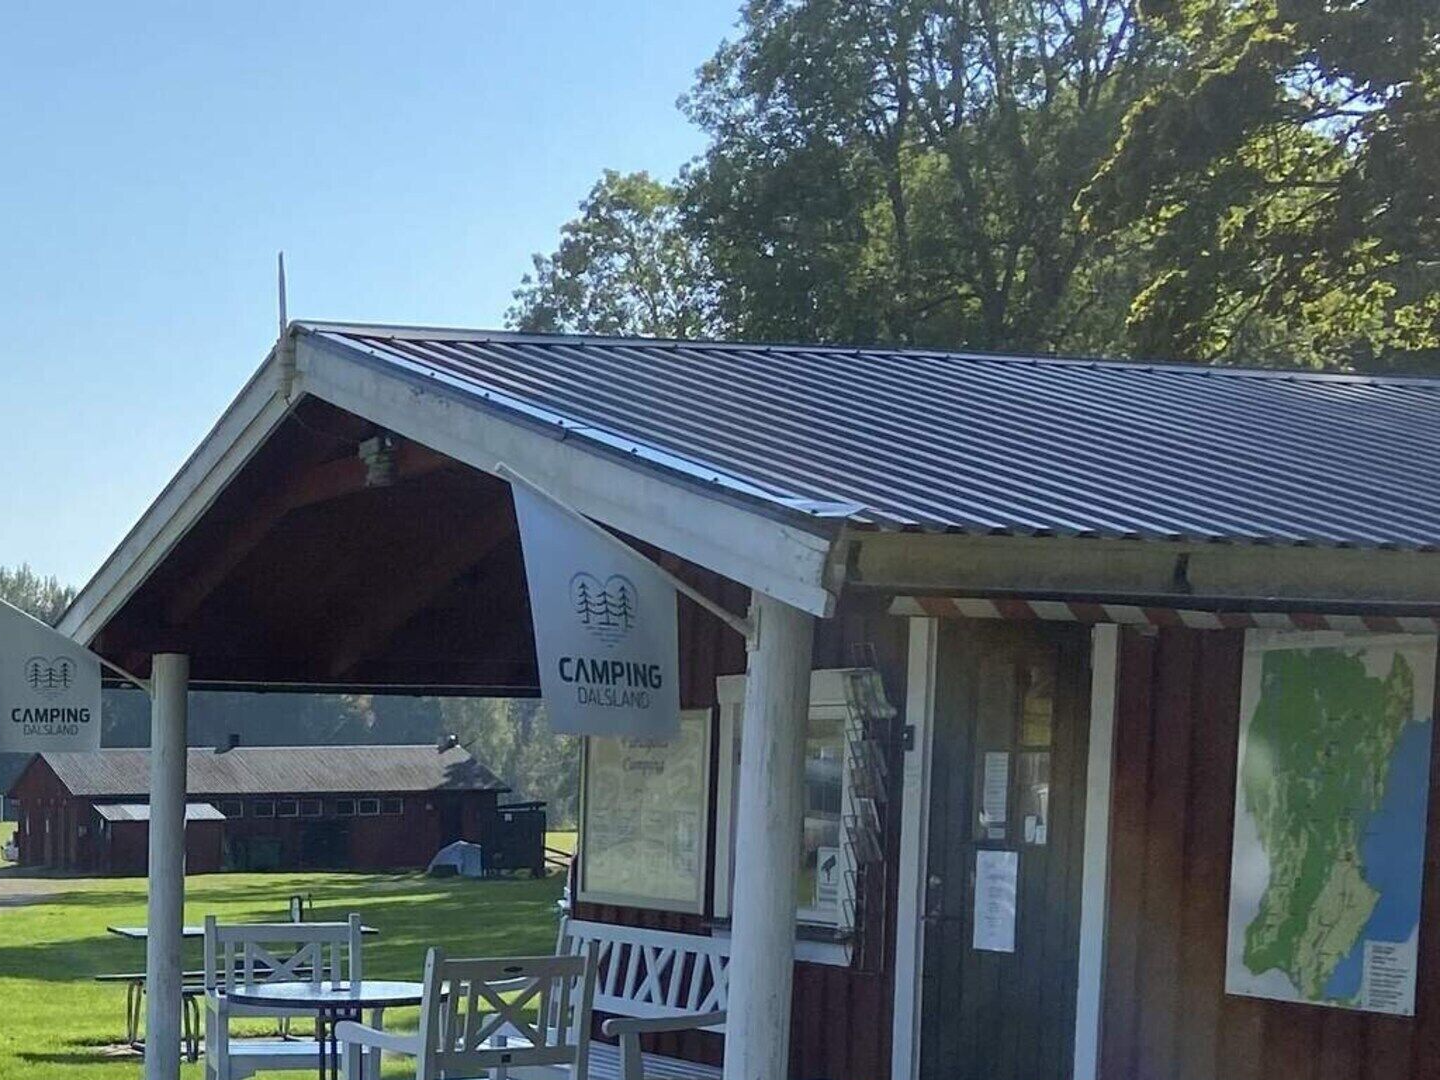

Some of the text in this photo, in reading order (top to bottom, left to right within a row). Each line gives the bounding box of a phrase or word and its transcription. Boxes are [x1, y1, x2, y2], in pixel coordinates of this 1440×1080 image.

[559, 657, 662, 689] CAMPING
[578, 687, 650, 709] DALSLAND
[12, 708, 90, 723] CAMPING
[23, 724, 78, 735] DALSLAND
